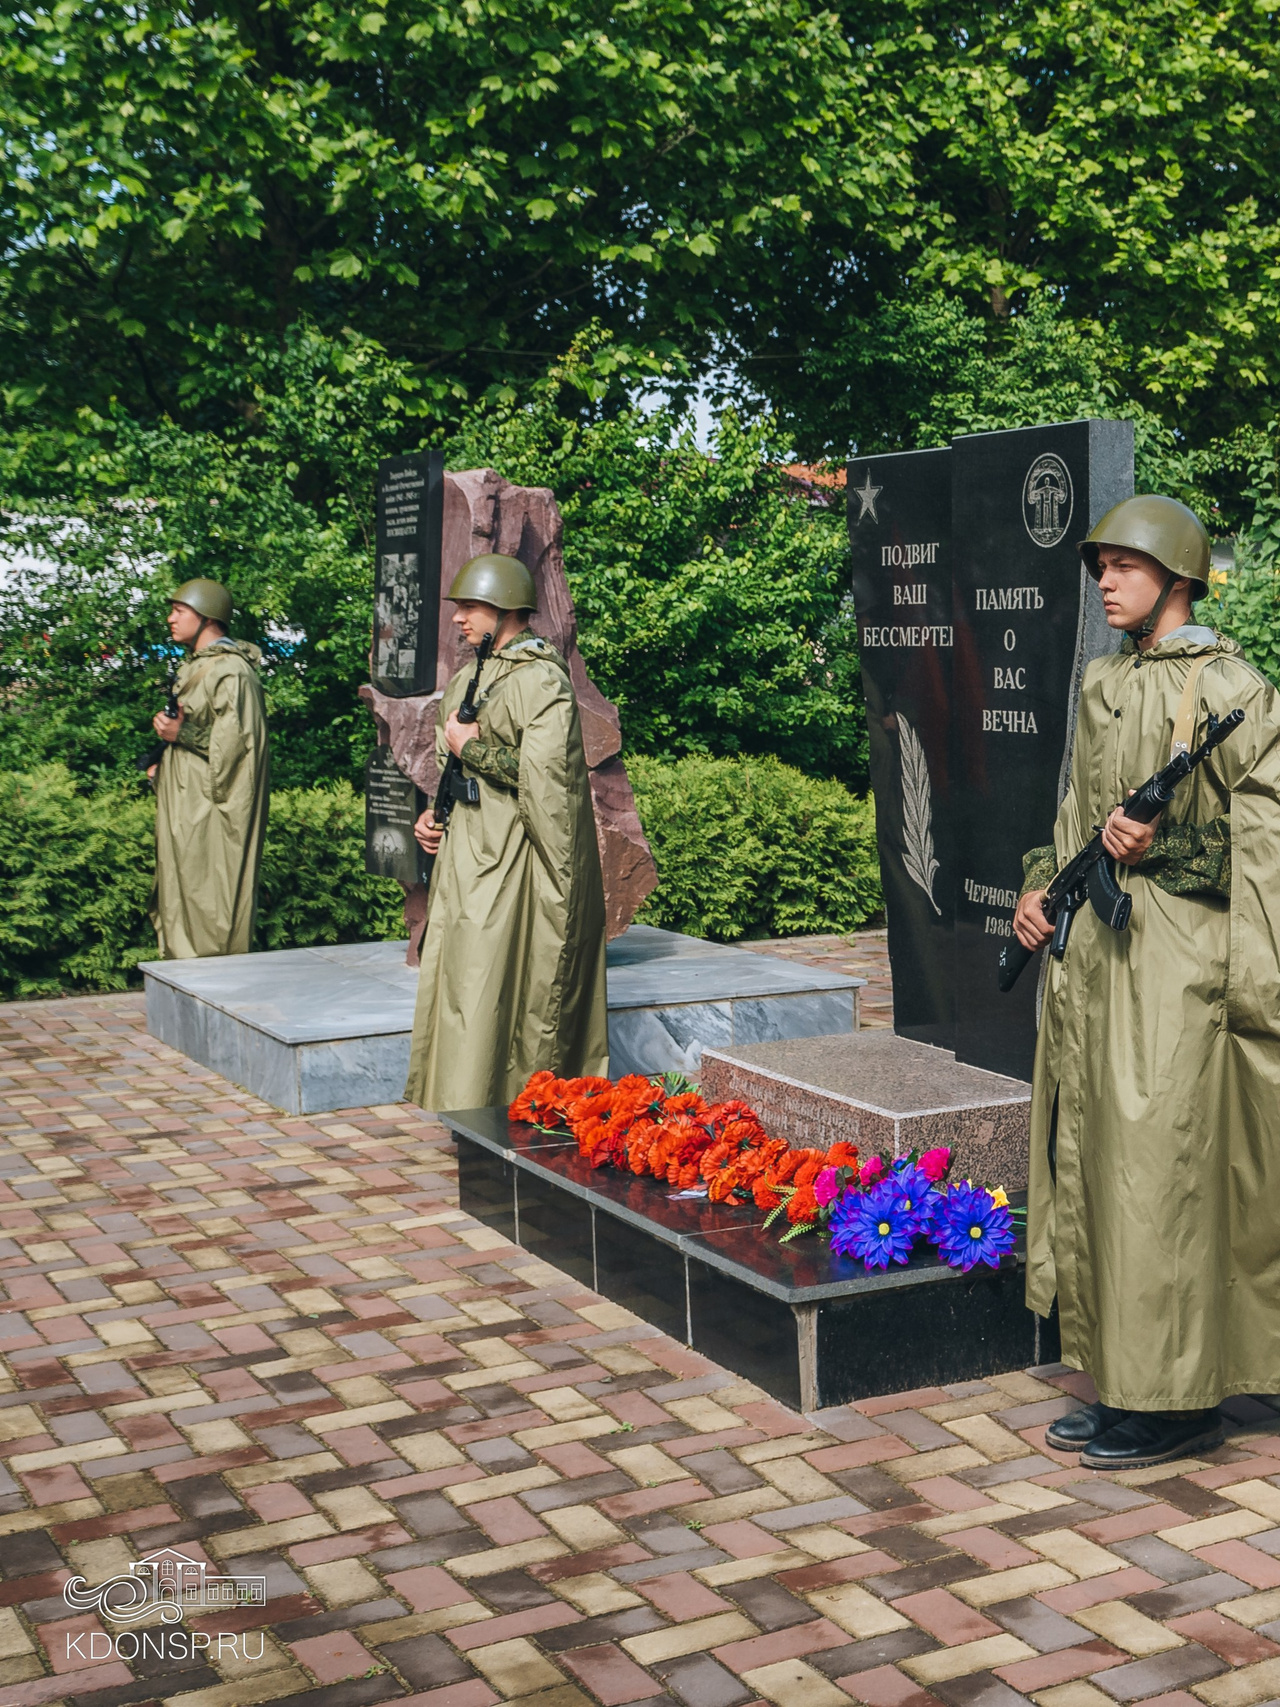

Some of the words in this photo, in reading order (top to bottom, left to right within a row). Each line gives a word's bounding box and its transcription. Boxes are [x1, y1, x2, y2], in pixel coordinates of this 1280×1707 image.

[881, 542, 940, 569] ПОДВИГ
[893, 584, 927, 605] ВАШ
[975, 586, 1045, 611] ПАМЯТЬ
[1003, 628, 1016, 652] О
[993, 667, 1026, 690] ВАС
[982, 709, 1038, 734] ВЕЧНА
[984, 915, 1012, 938] 1986
